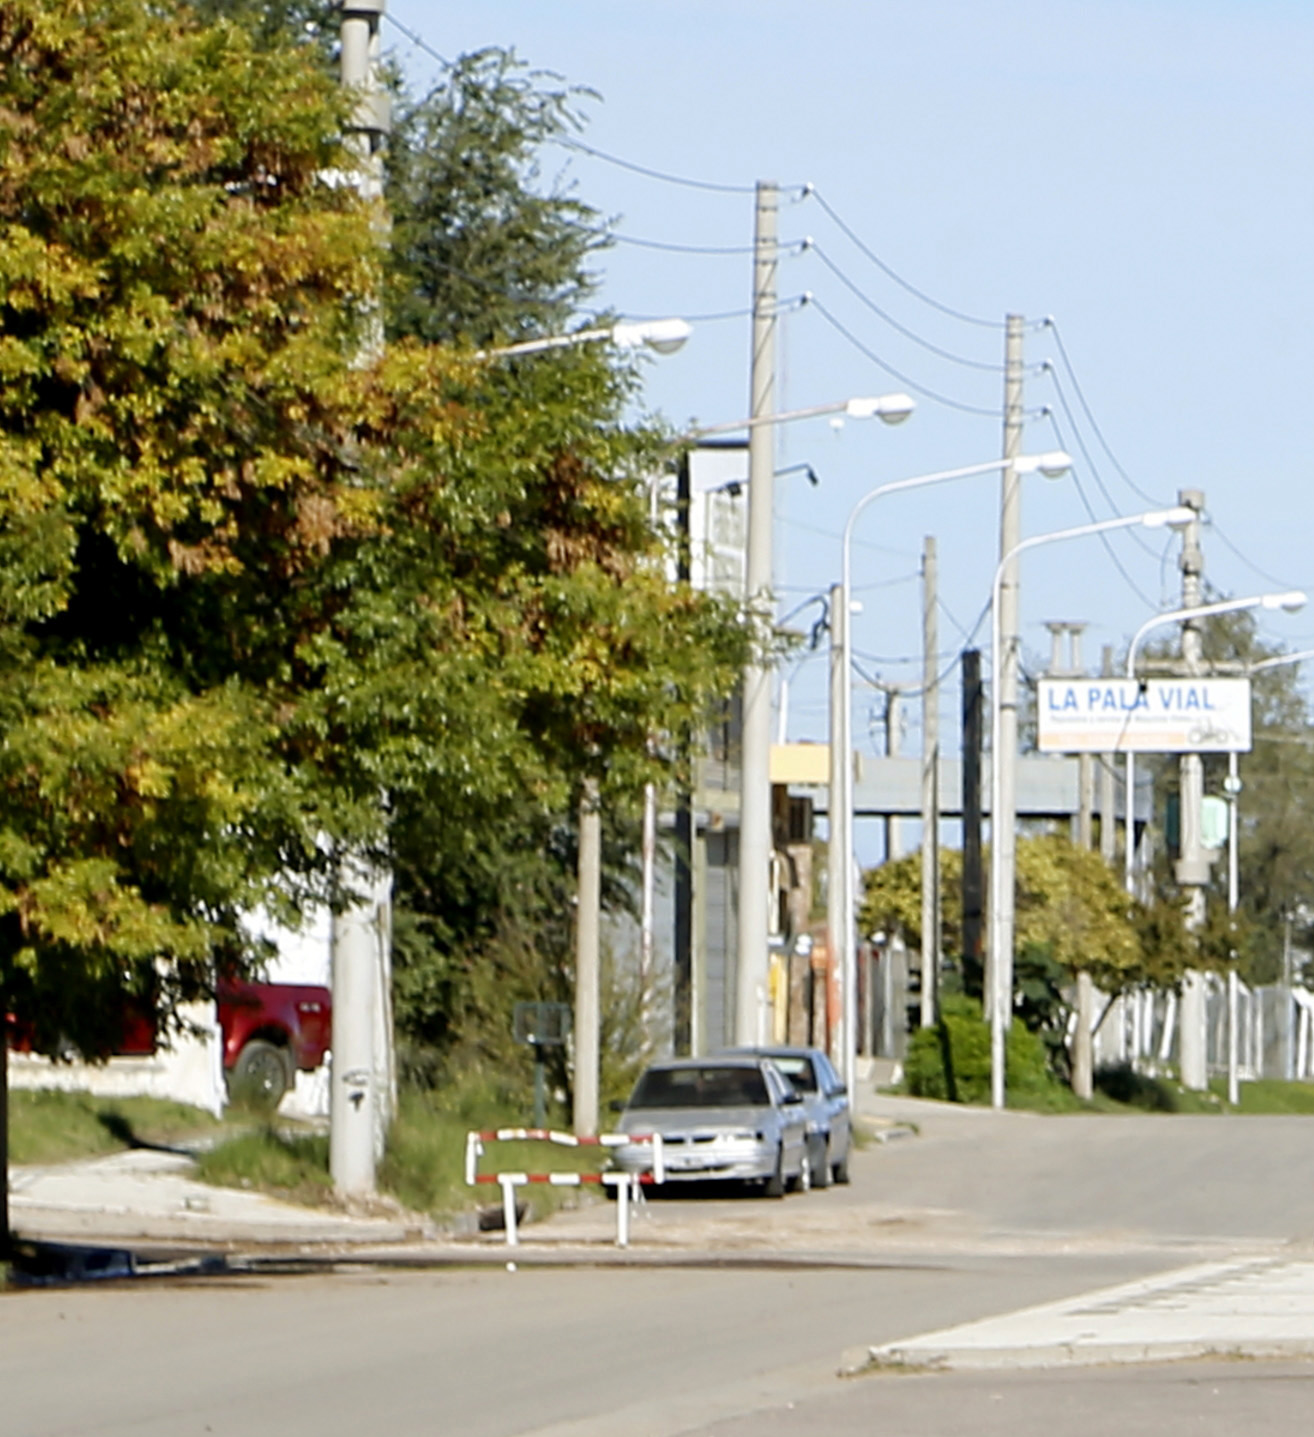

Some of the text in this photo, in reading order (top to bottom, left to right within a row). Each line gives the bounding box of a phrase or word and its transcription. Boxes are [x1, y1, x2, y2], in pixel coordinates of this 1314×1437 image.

[1047, 687, 1215, 711] LA PALA VIAL
